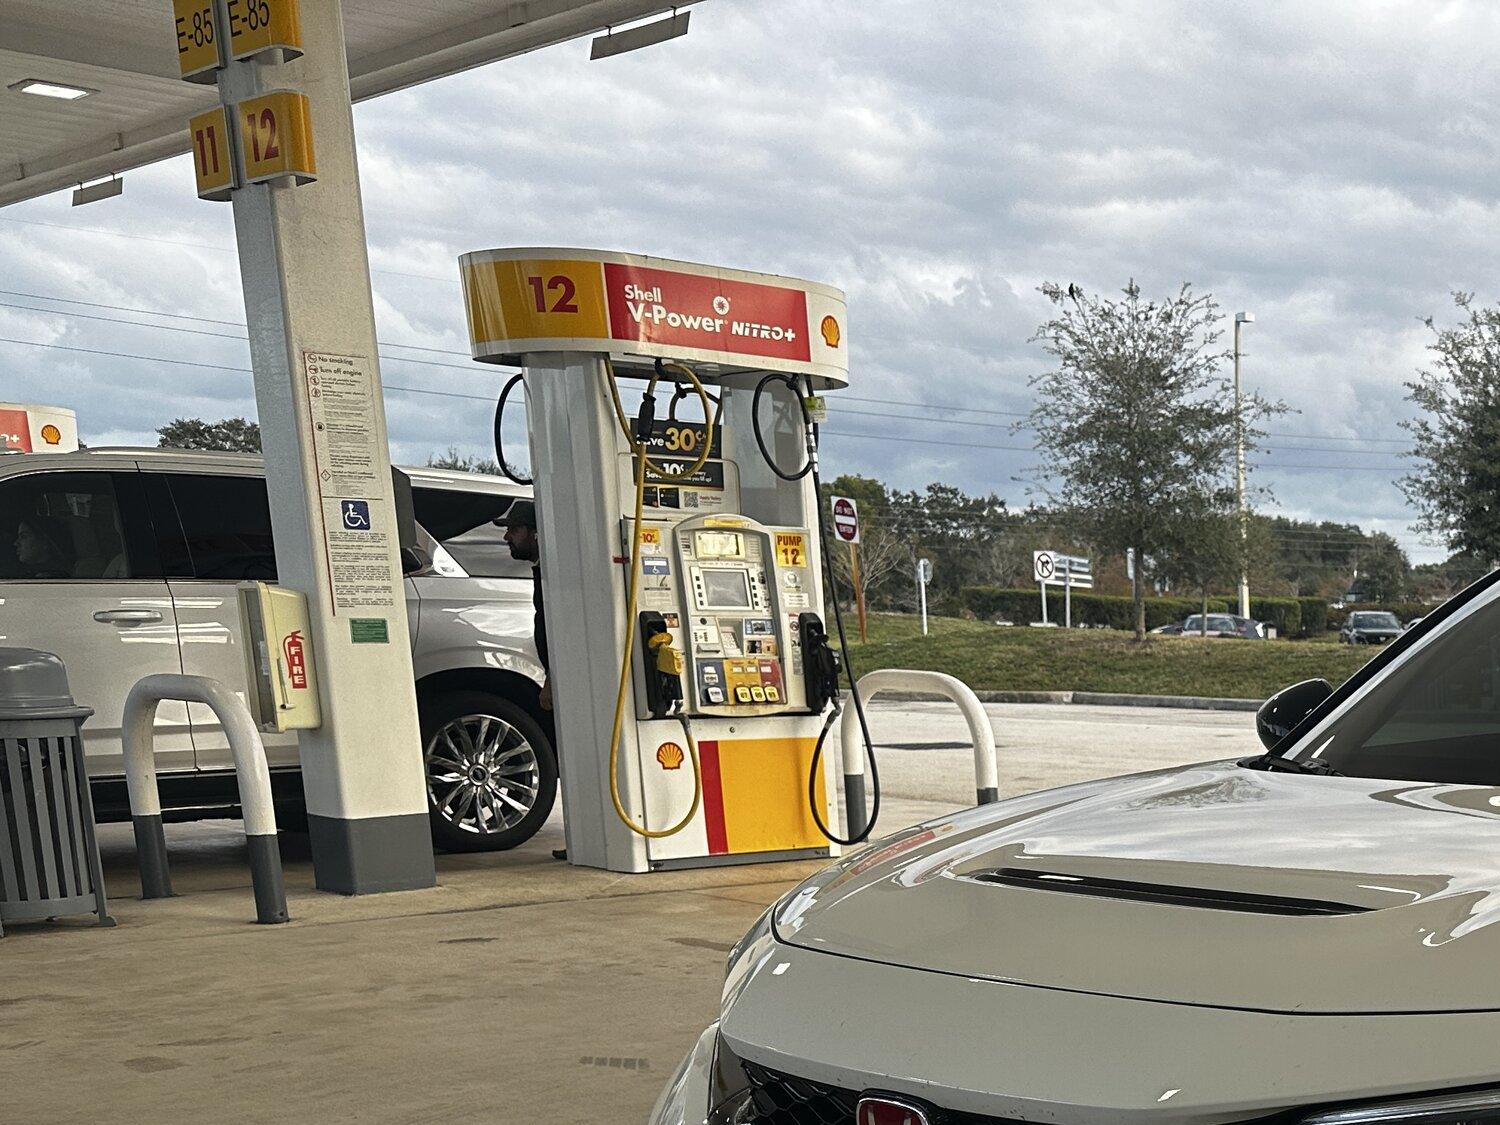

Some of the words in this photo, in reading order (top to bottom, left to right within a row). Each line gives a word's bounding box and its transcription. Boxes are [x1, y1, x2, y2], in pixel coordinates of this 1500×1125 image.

[175, 8, 214, 54] E-85
[228, 0, 270, 38] E-85
[195, 125, 219, 176] 11
[247, 108, 279, 162] 12
[528, 275, 579, 314] 12
[624, 284, 662, 303] Shell
[626, 301, 724, 333] V-Power
[777, 535, 802, 546] PUMP
[782, 548, 801, 565] 12
[290, 646, 304, 684] FIRE
